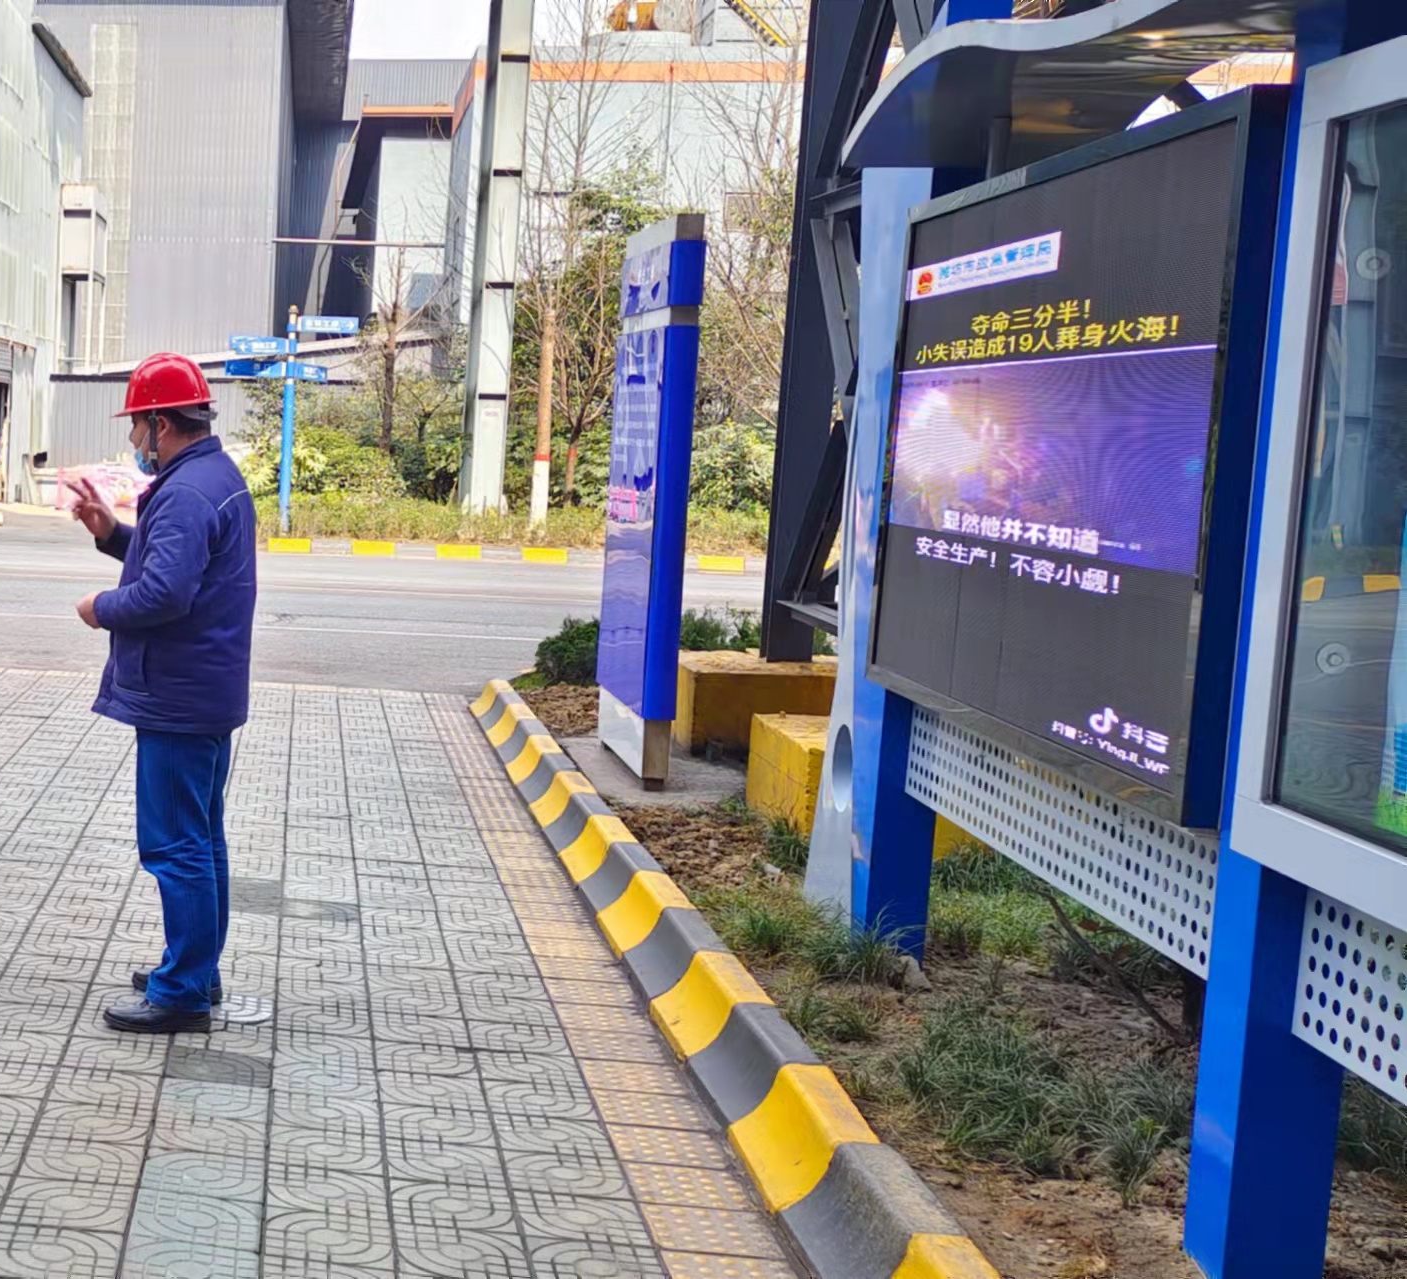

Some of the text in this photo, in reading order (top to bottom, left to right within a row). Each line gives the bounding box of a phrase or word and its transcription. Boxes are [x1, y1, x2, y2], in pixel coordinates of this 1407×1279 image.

[942, 509, 1099, 555] 显然他并不知道
